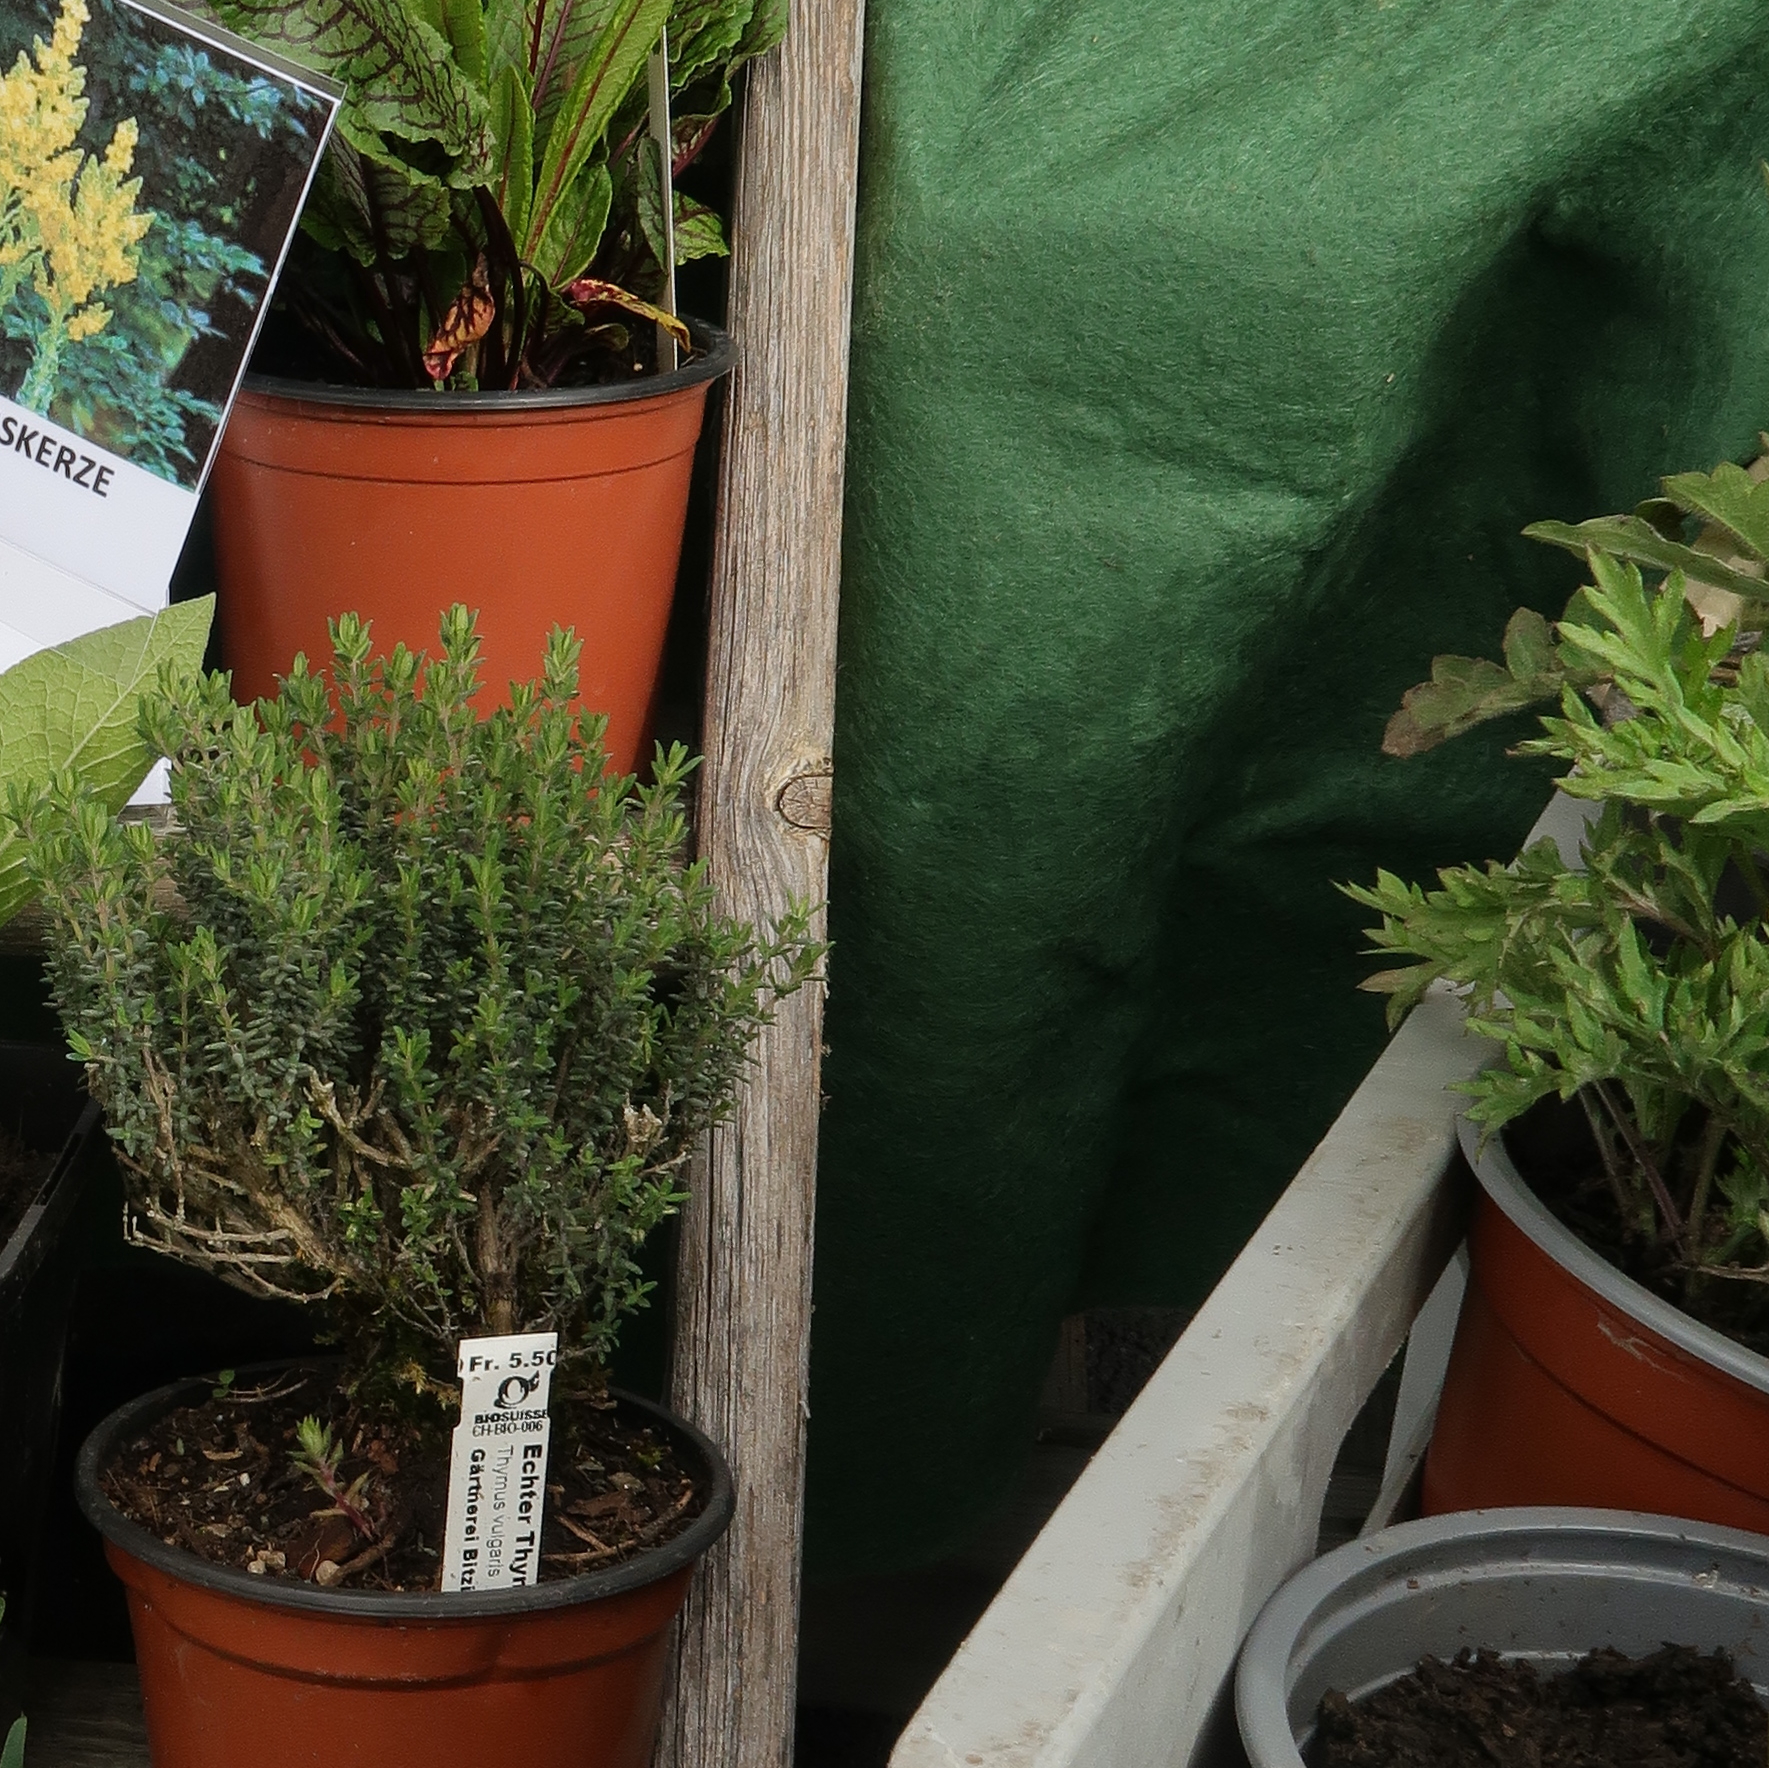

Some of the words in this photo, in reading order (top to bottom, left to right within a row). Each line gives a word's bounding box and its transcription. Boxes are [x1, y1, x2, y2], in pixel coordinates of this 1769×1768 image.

[469, 1355, 500, 1373] Fr.
[508, 1349, 558, 1369] 5.50
[463, 1448, 486, 1543] Gärtnerei
[492, 1443, 514, 1512] Thymus
[516, 1443, 543, 1525] Echter
[460, 1548, 479, 1592] Bitzi
[485, 1514, 505, 1578] vulgaris
